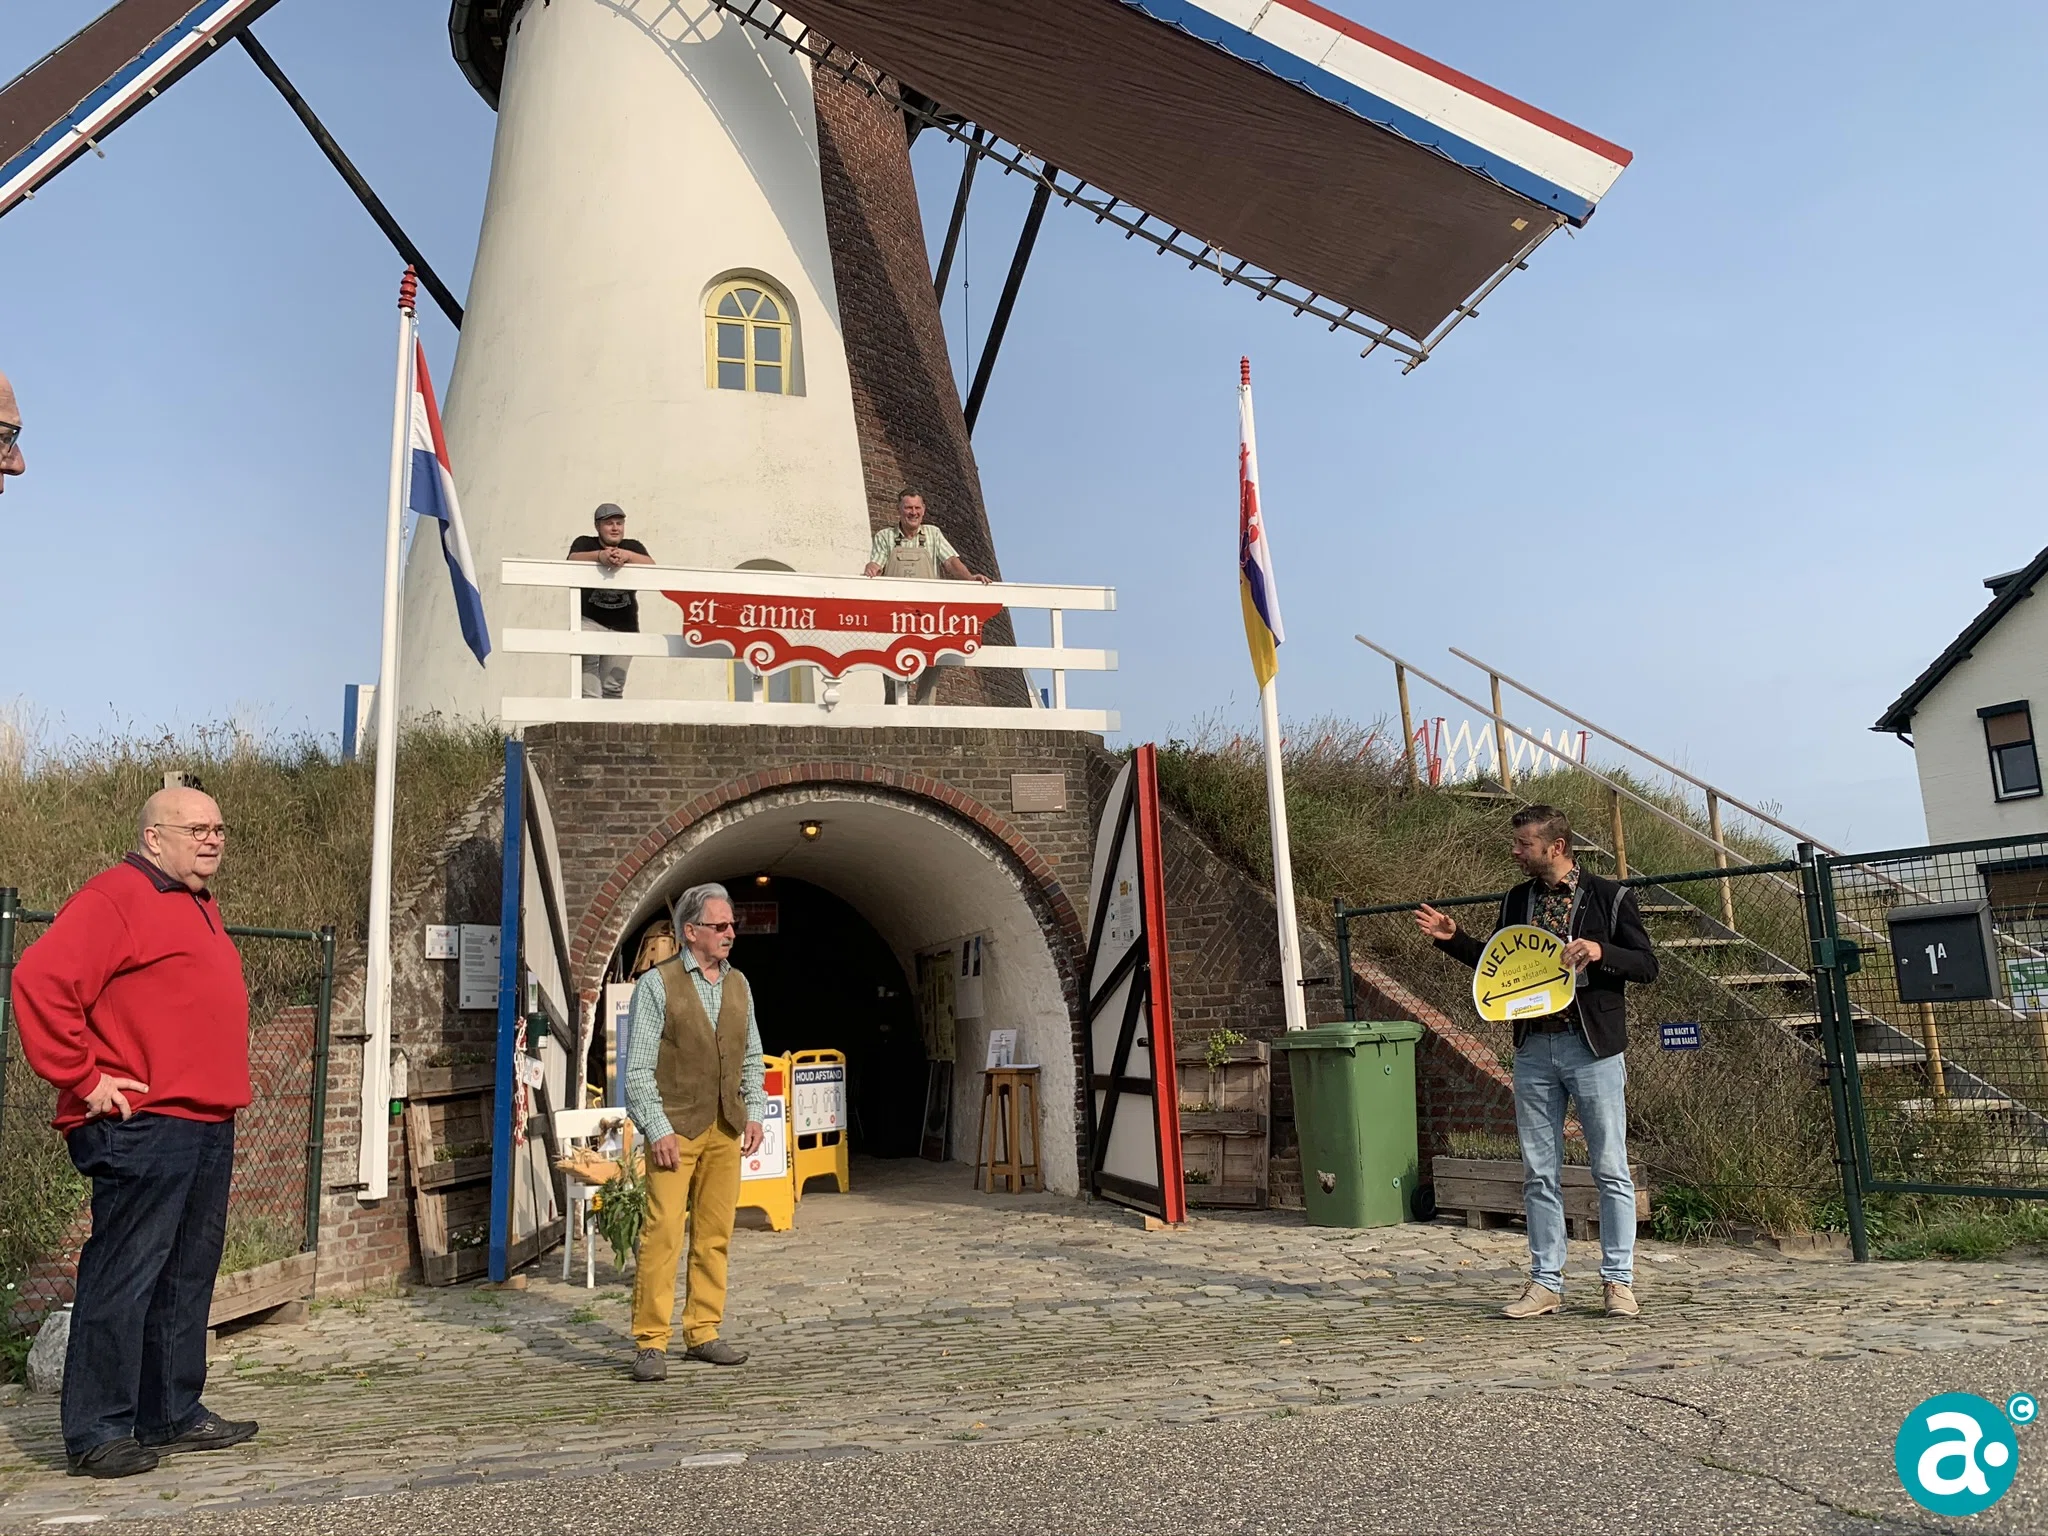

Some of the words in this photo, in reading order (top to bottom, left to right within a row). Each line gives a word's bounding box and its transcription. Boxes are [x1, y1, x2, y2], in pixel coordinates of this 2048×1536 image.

[689, 598, 718, 624] st
[738, 603, 816, 629] anna
[838, 613, 869, 627] 1911
[891, 606, 979, 636] molen
[1481, 933, 1558, 978] WELKOM
[1502, 966, 1521, 977] Houd
[1522, 967, 1548, 981] afstand
[1674, 1027, 1689, 1035] WACHT
[1689, 1026, 1695, 1035] IK
[795, 1071, 815, 1082] HOUD
[815, 1070, 842, 1080] AFSTAND
